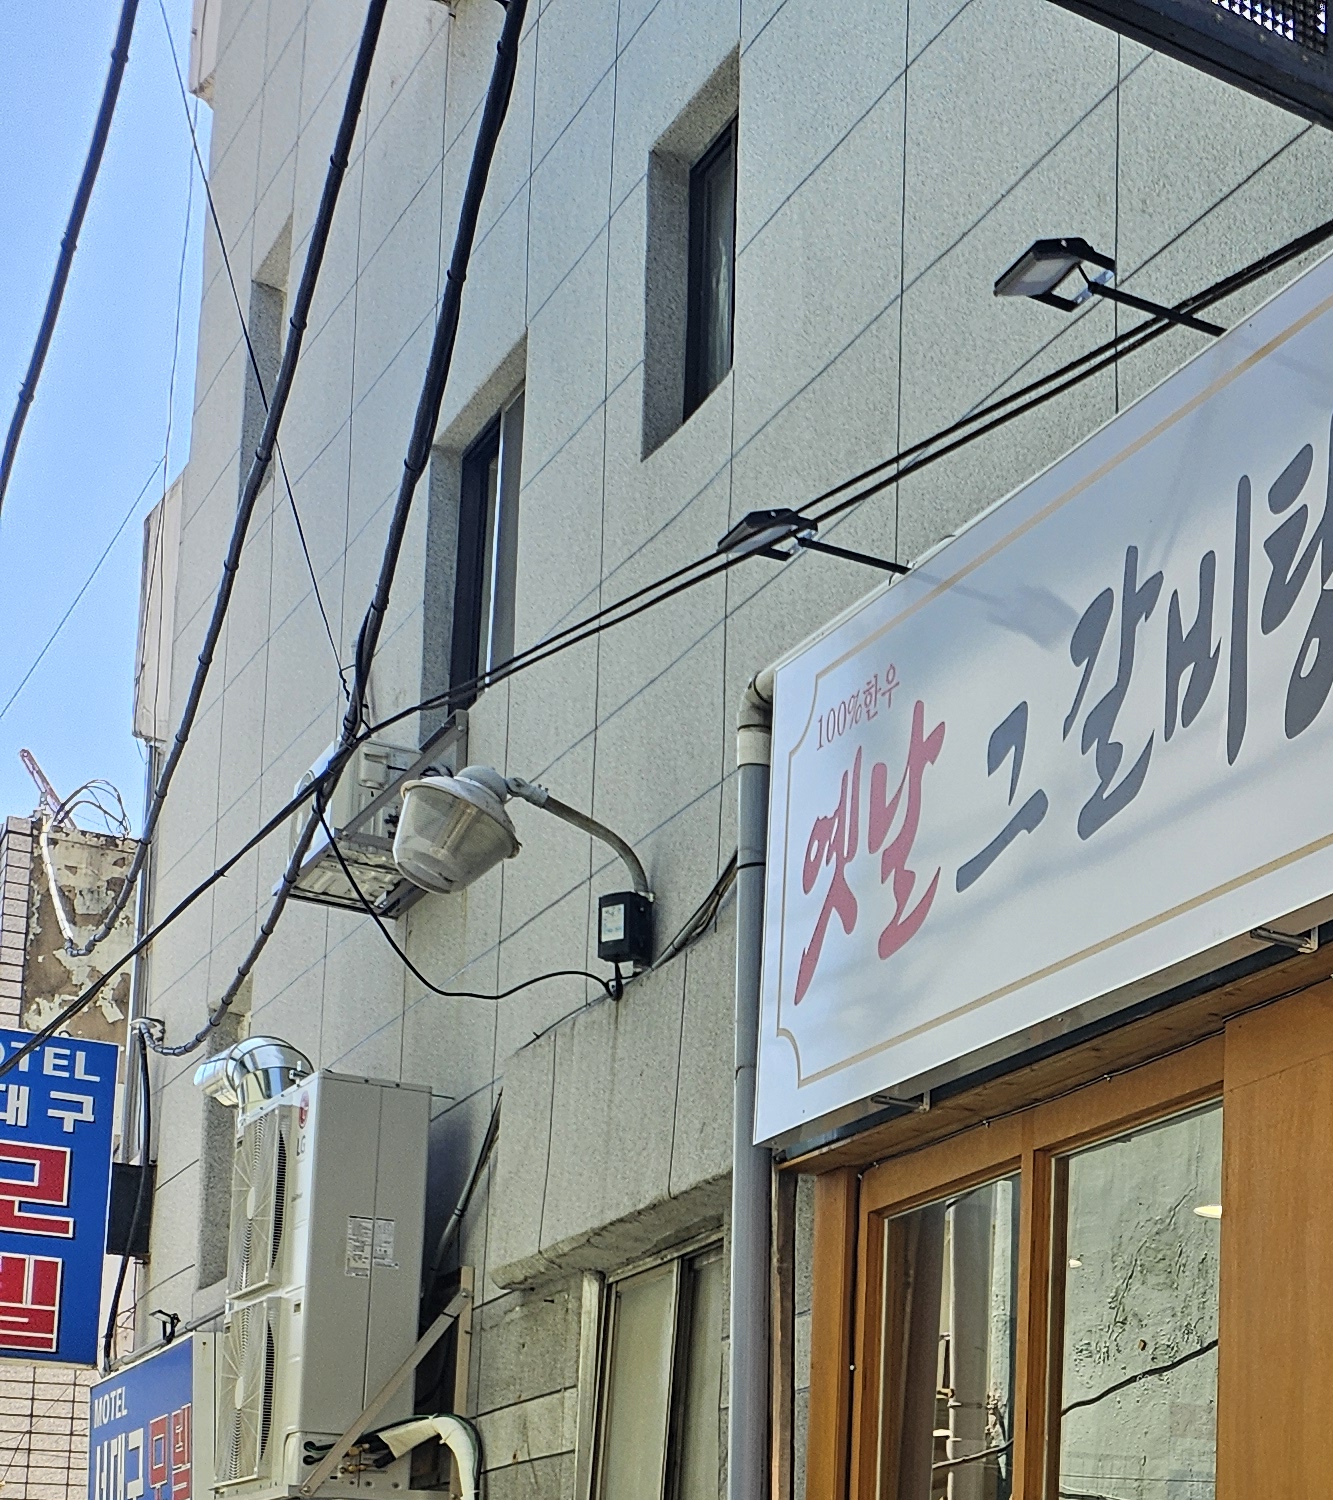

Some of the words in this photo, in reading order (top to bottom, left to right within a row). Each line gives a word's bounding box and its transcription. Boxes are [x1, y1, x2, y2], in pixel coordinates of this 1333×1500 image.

[814, 662, 901, 752] 100%한우
[794, 700, 946, 1006] 옛날
[956, 701, 1049, 894] 그
[94, 1386, 128, 1429] MOTEL
